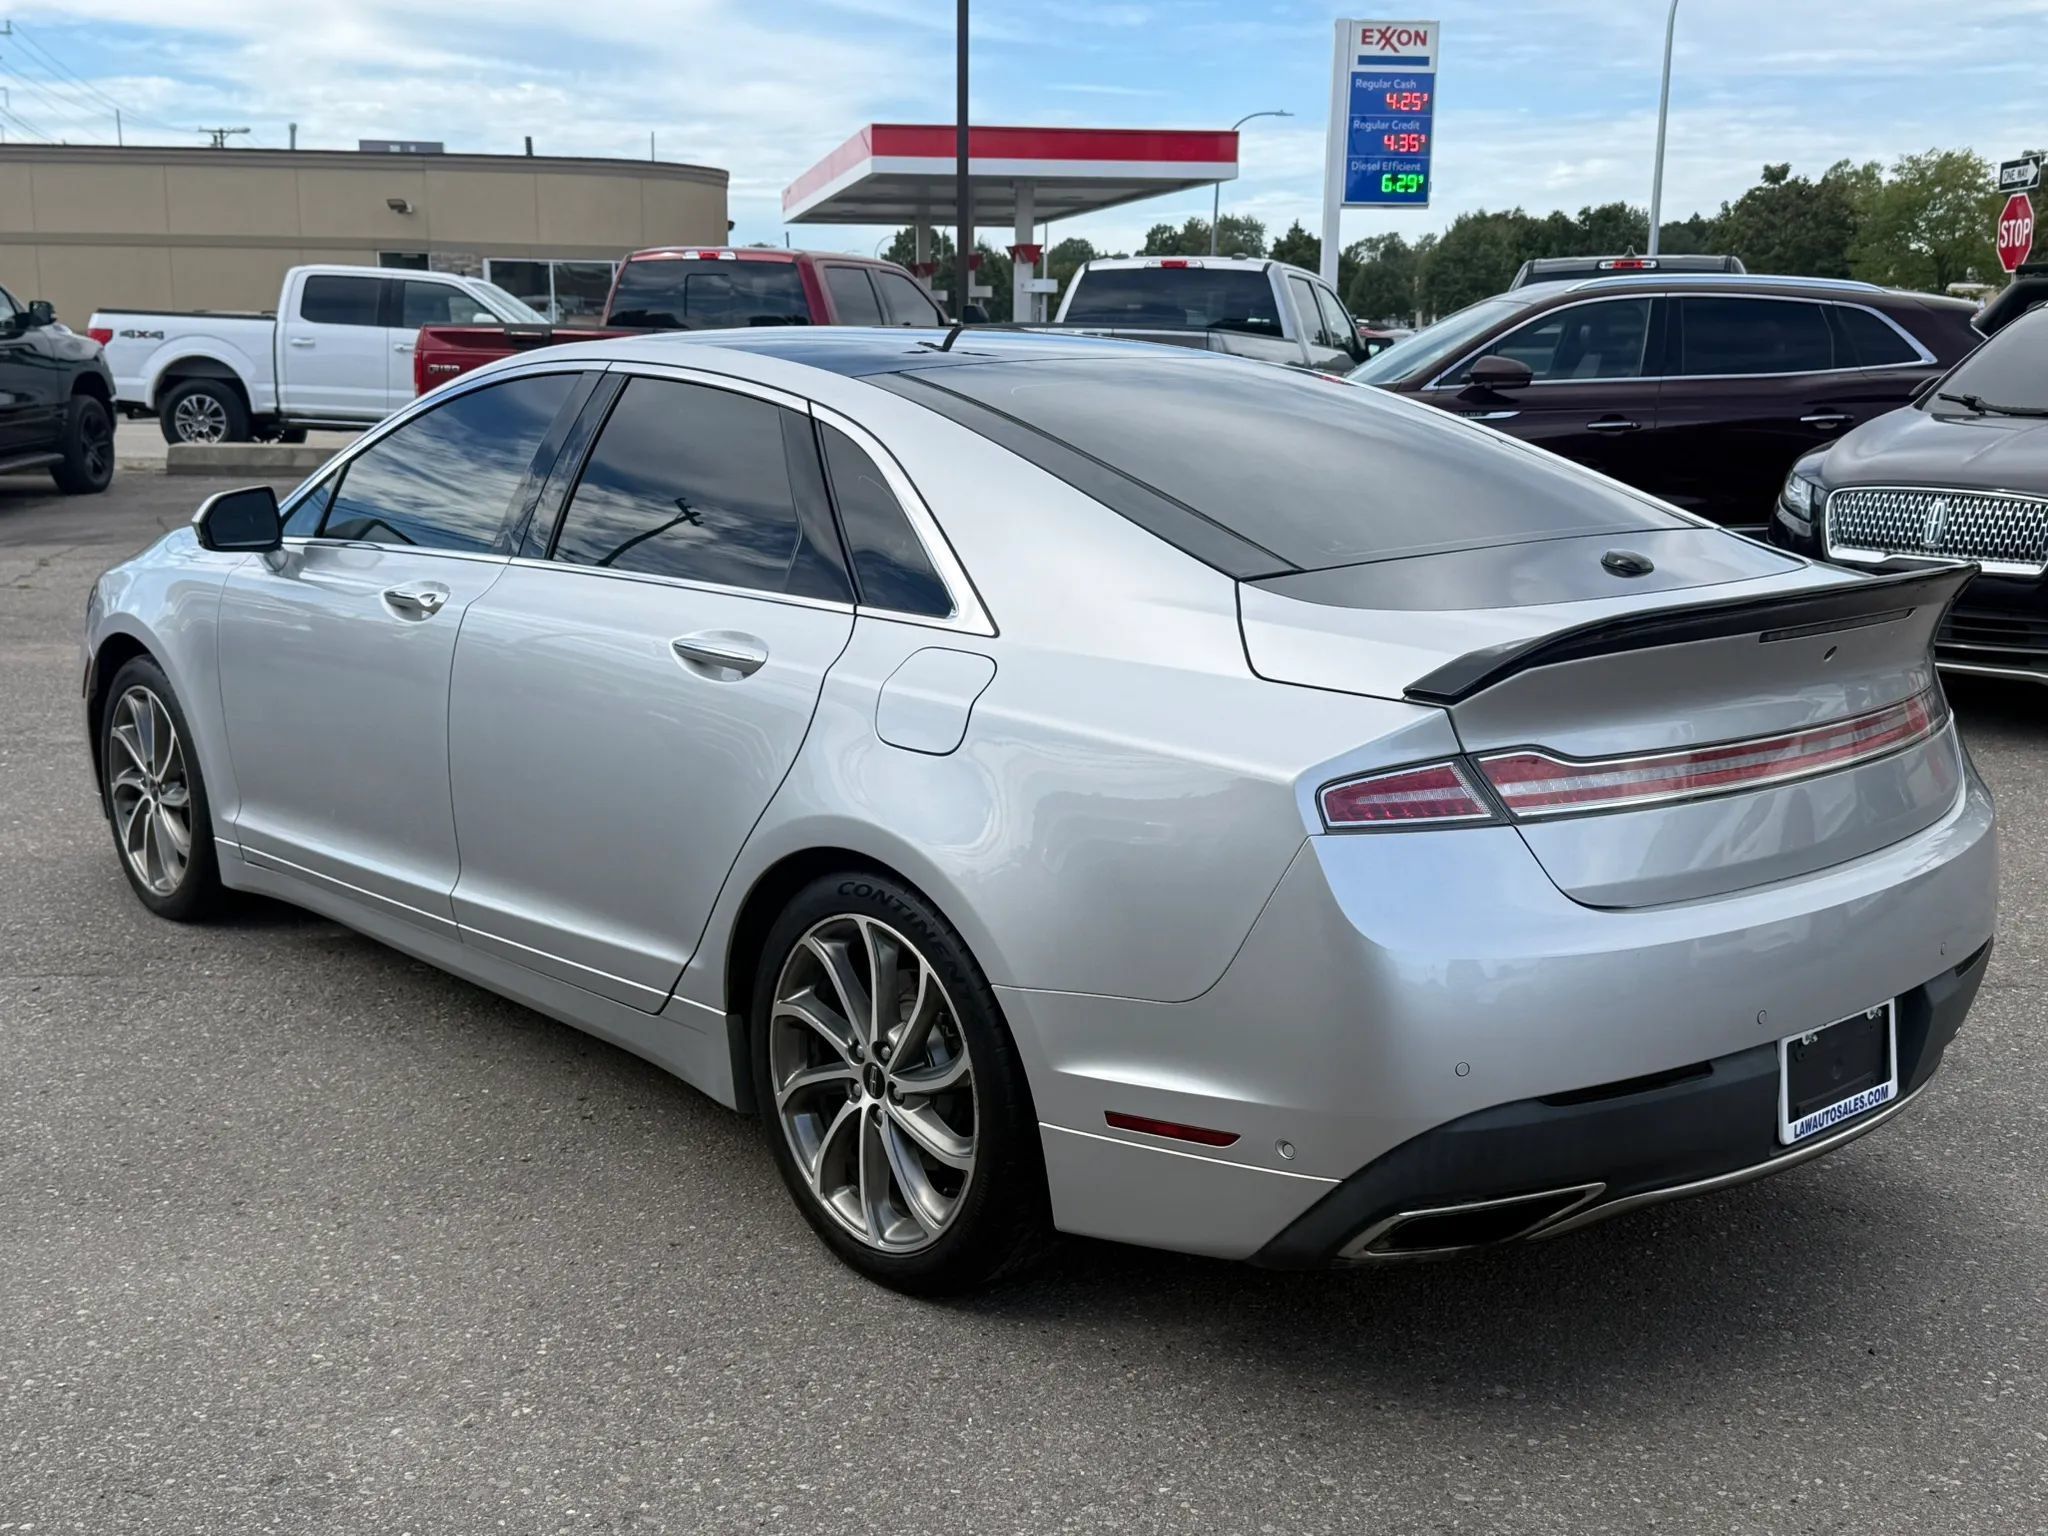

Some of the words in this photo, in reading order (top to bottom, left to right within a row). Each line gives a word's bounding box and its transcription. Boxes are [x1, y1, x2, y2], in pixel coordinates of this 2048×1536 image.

[1361, 25, 1428, 53] EXXON
[1355, 79, 1392, 91] Regular
[1394, 79, 1417, 89] Cash
[1353, 120, 1389, 132] Regular
[1392, 120, 1420, 130] Credit
[1351, 161, 1380, 171] Diesel
[1382, 161, 1421, 171] Efficient
[2003, 169, 2015, 182] ONE
[2017, 167, 2029, 179] WAY
[2000, 218, 2031, 248] STOP
[1794, 1085, 1889, 1138] LAWAUTOSALES.COM
